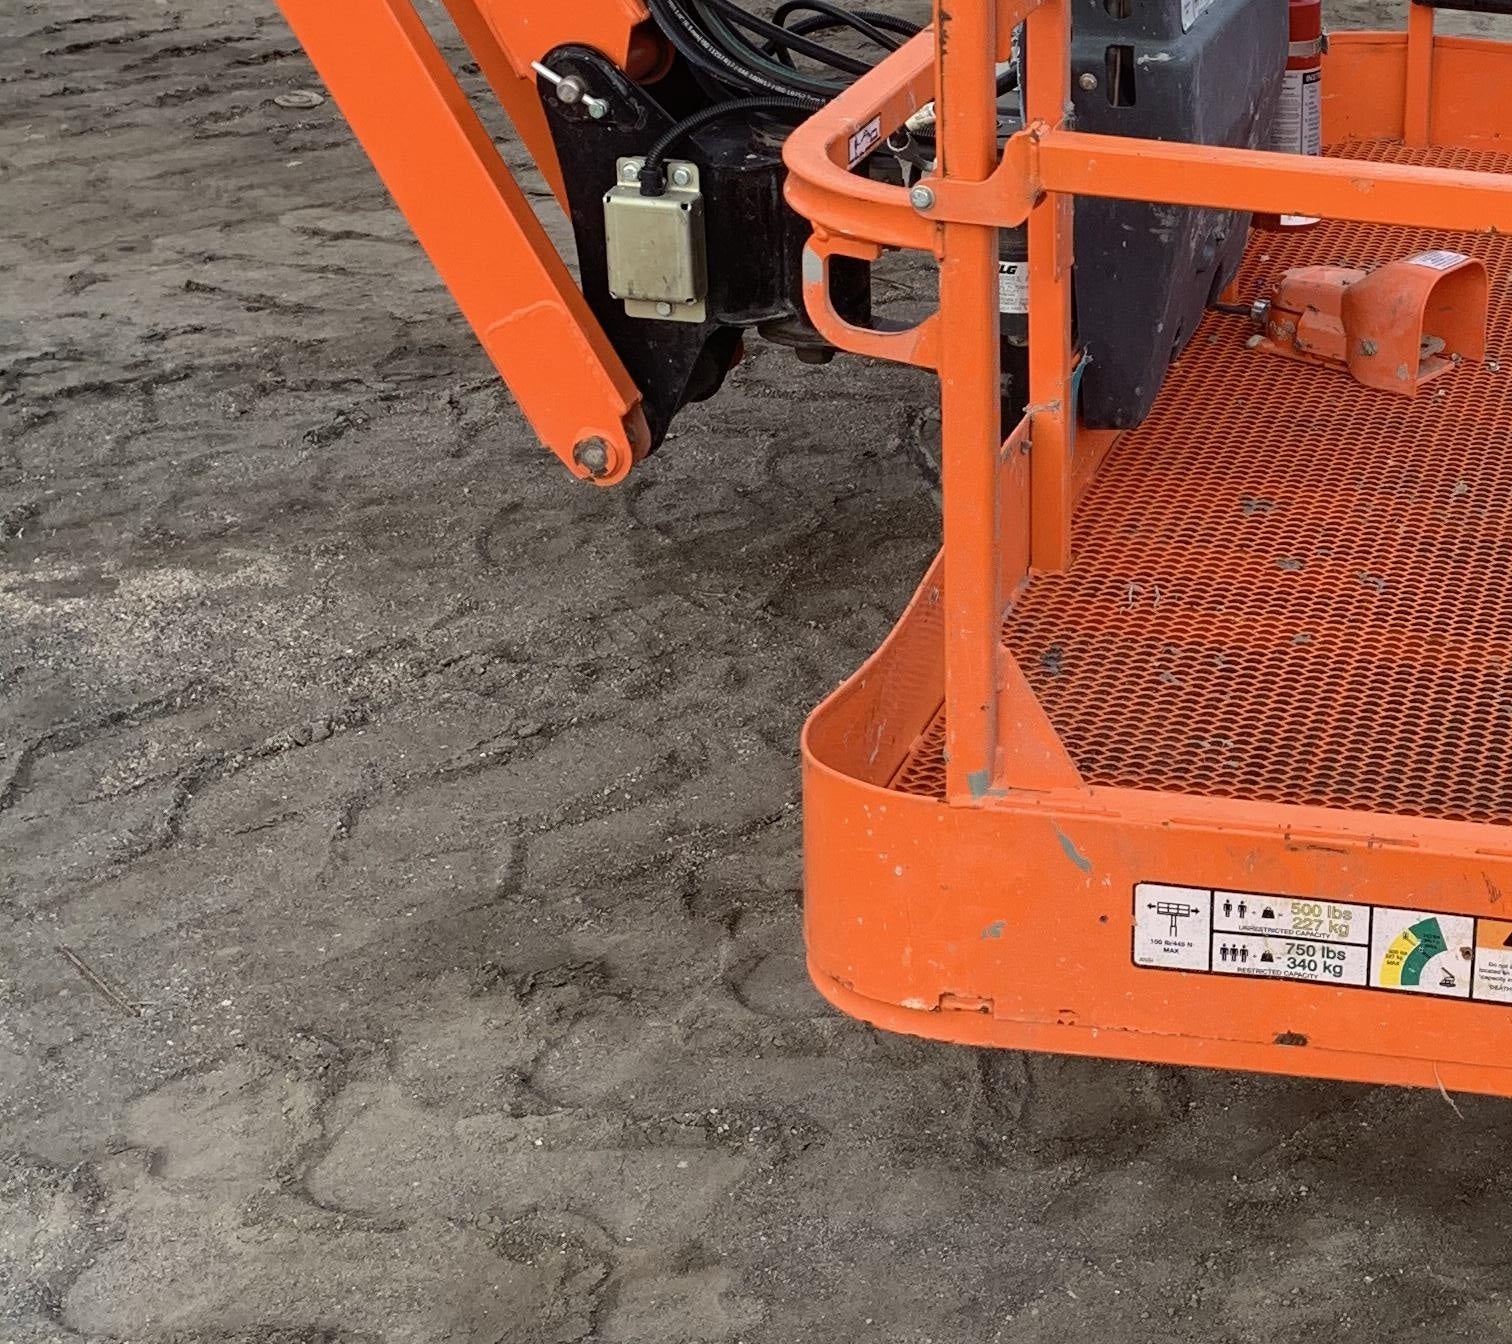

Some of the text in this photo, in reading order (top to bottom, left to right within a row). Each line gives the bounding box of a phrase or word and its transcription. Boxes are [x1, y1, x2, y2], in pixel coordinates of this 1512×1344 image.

[999, 265, 1018, 274] LG
[1290, 902, 1353, 921] 500 lbs
[1292, 917, 1349, 938] 227 kg
[1295, 930, 1331, 939] CAPACITY
[1285, 942, 1346, 961] 750 lbs
[1237, 967, 1319, 980] RESTRICTED CAPACITY
[1286, 957, 1343, 978] 340 kg
